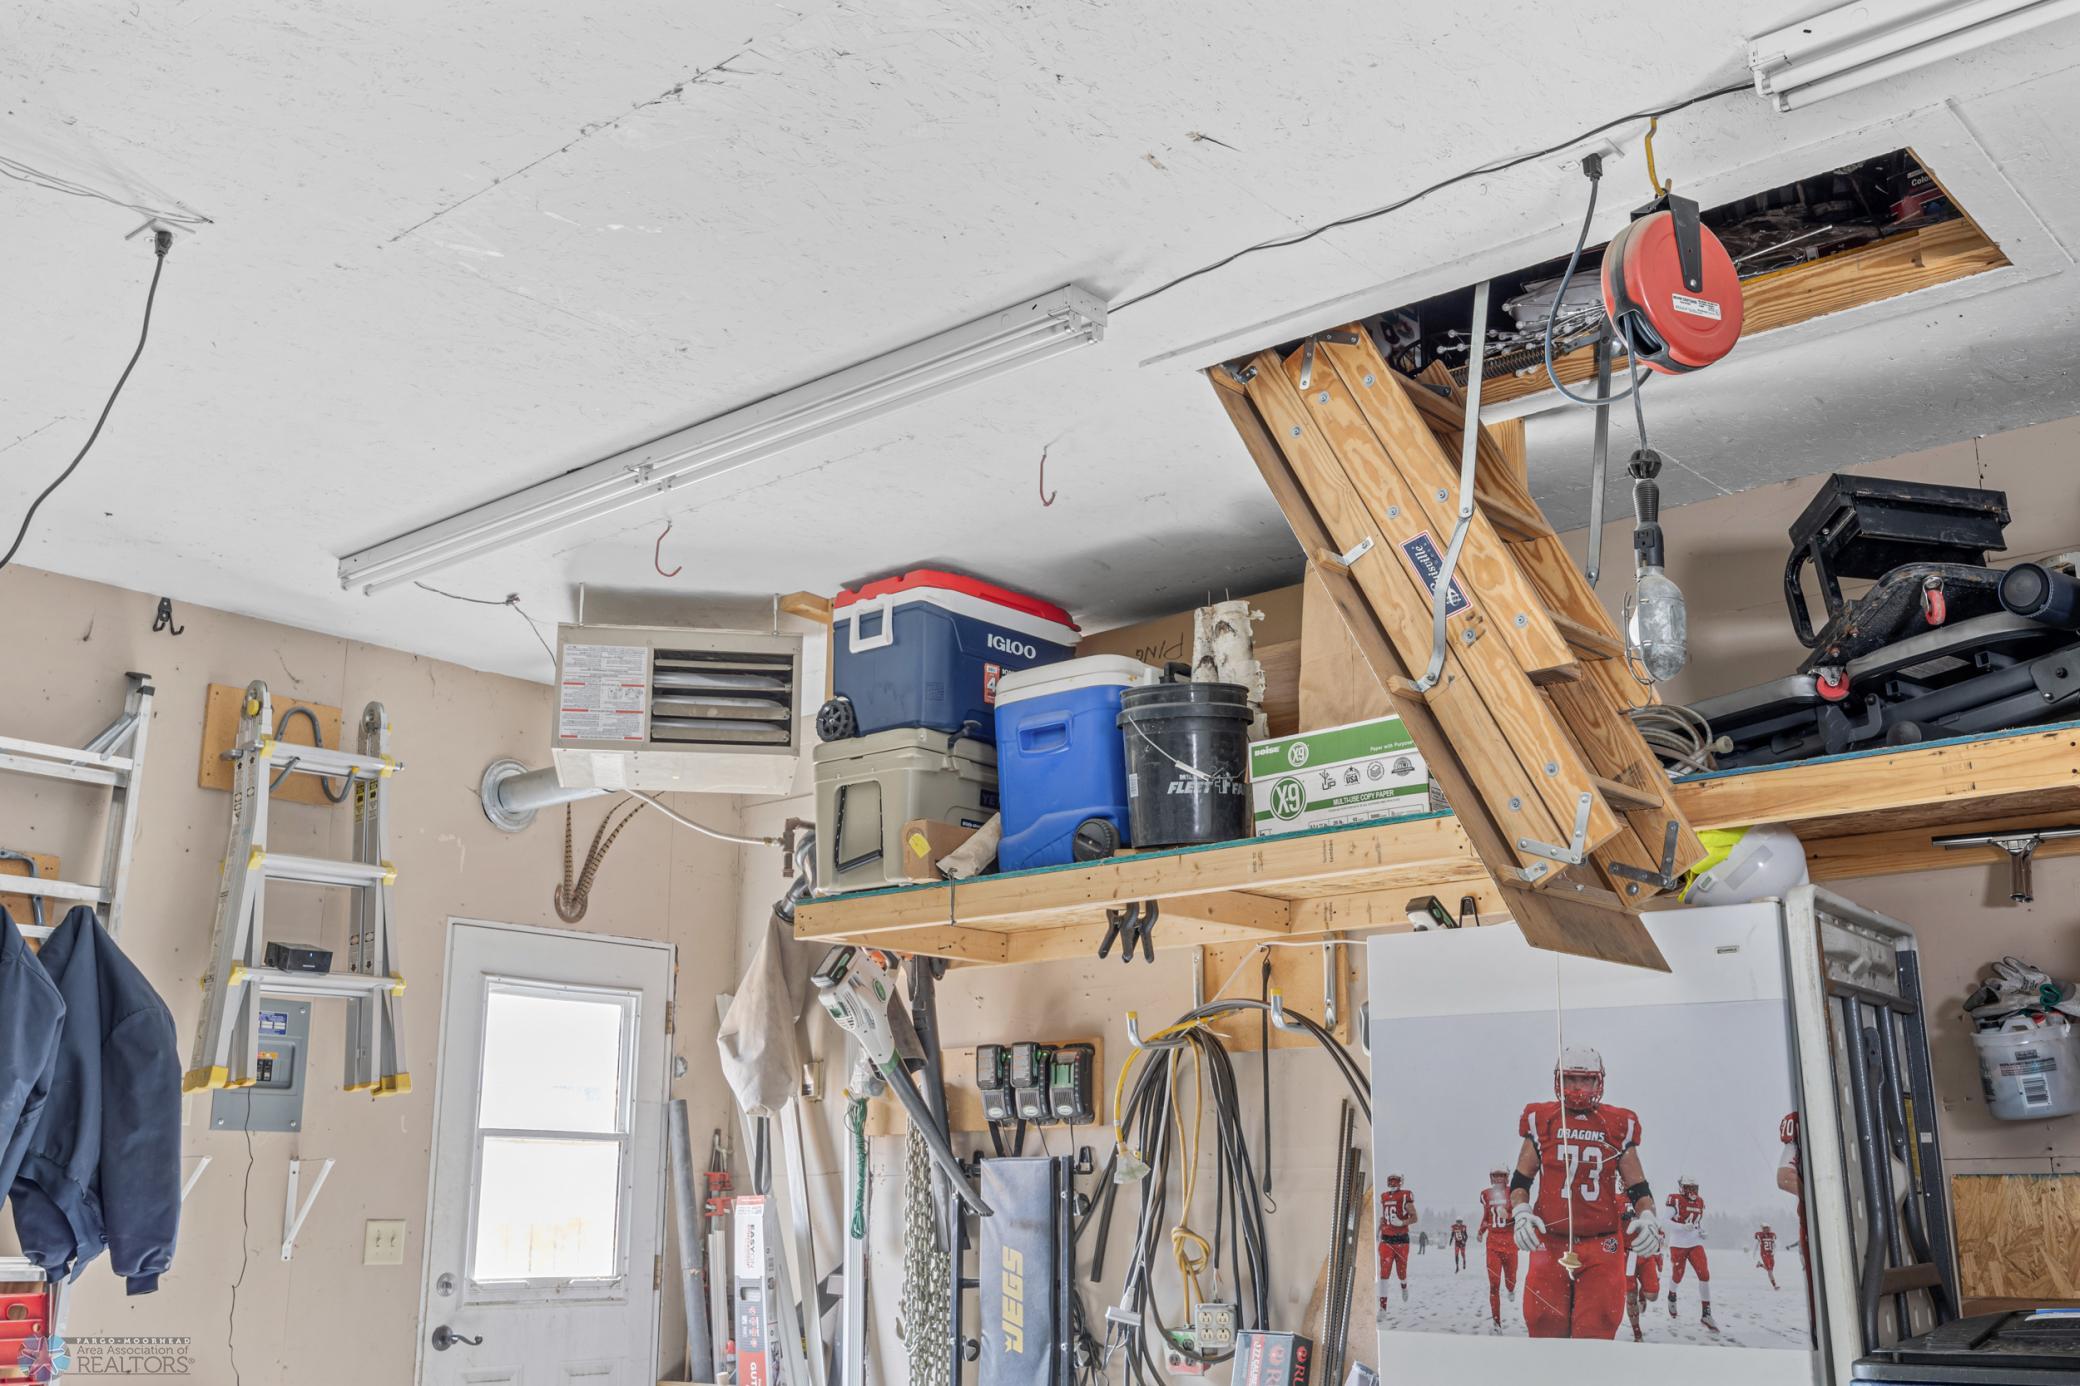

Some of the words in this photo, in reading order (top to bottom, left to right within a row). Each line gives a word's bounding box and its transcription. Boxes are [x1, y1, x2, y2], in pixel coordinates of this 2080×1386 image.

[987, 633, 1037, 659] IGLOO
[1345, 776, 1359, 784] USA
[1167, 781, 1213, 794] FLEET
[1232, 782, 1244, 795] FA
[1360, 792, 1375, 802] COPY
[1376, 789, 1395, 798] PAPER
[1556, 1128, 1606, 1141] DRAGONS
[1557, 1144, 1603, 1202] 73
[1002, 1245, 1024, 1354] JEGS
